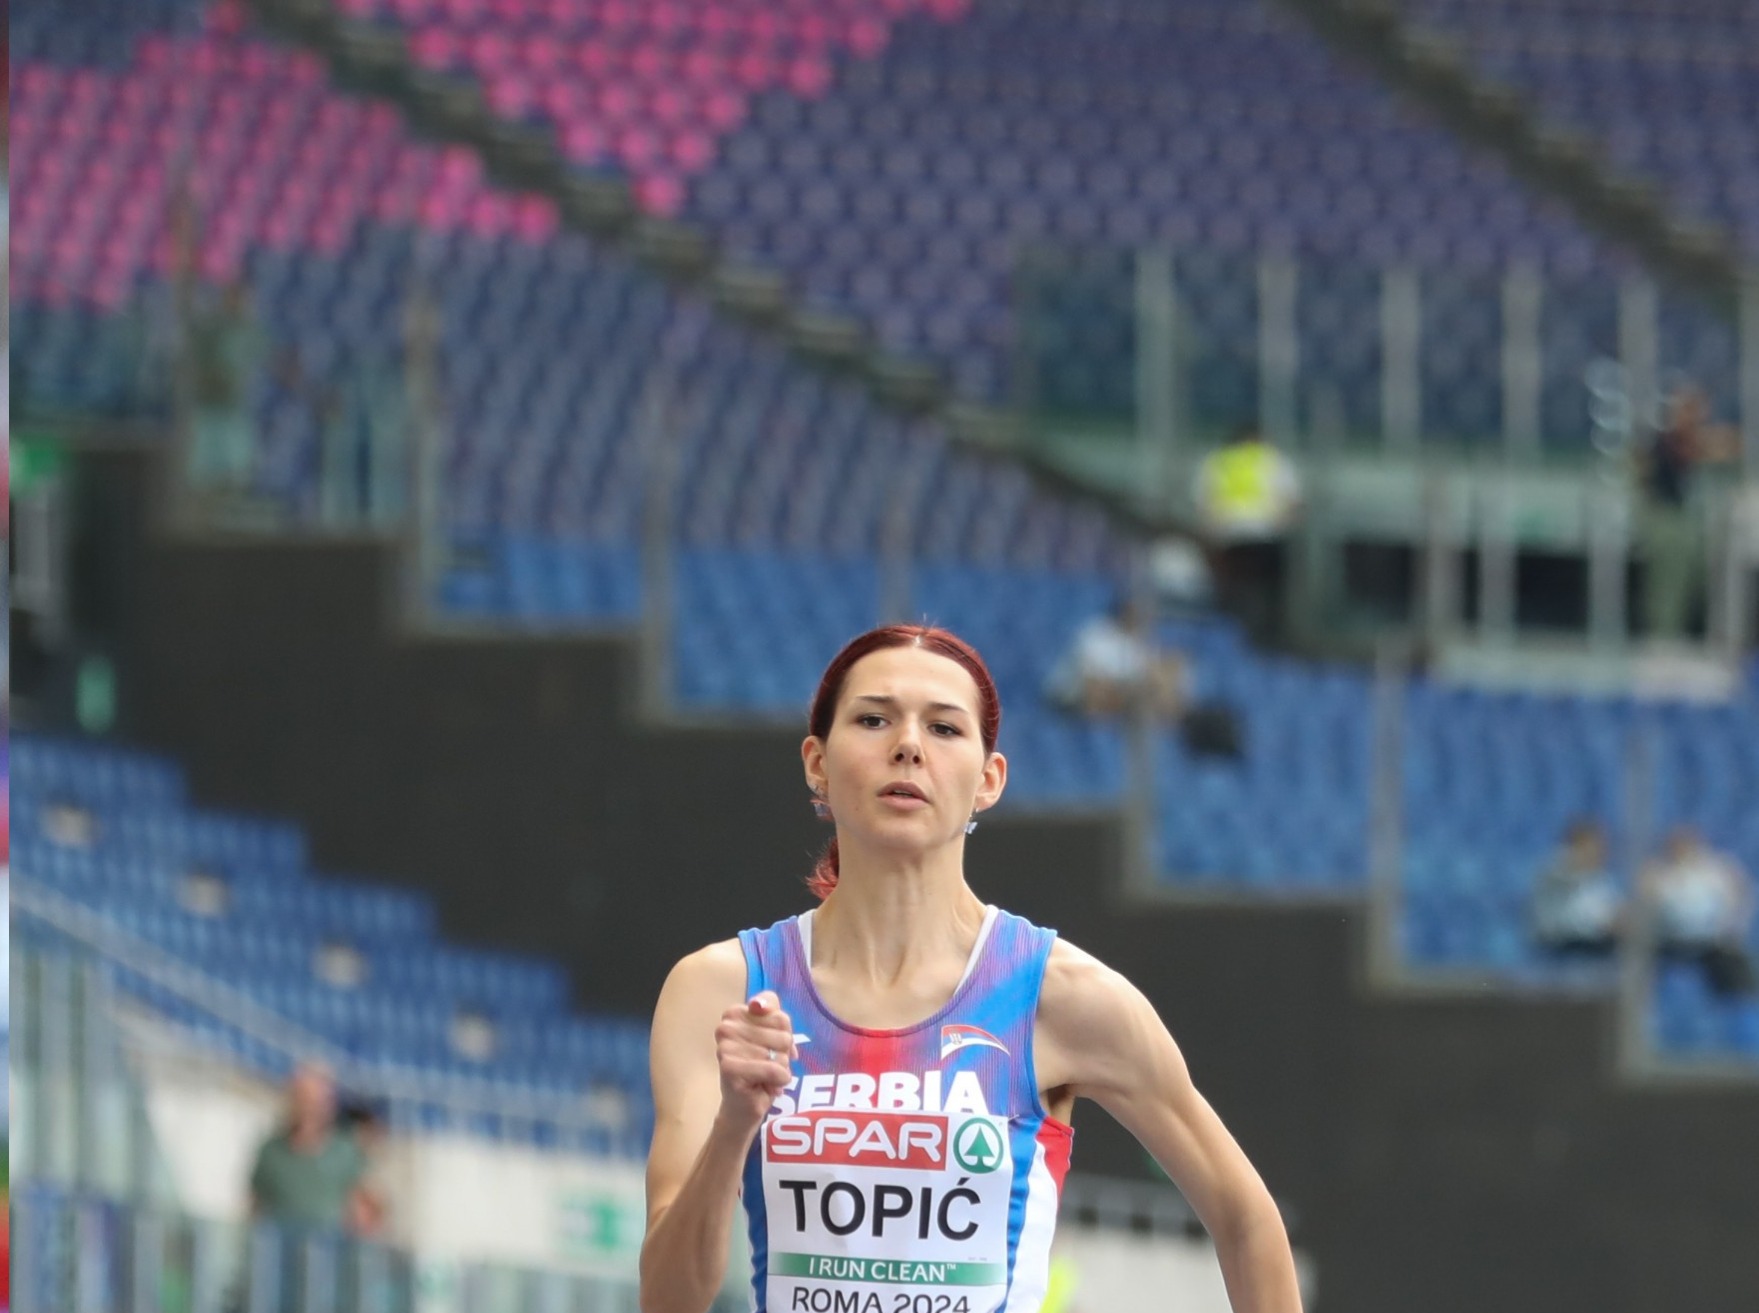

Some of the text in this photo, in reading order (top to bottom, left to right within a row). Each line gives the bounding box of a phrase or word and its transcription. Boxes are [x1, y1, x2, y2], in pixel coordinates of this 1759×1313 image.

[771, 1117, 942, 1162] SPAR
[779, 1177, 981, 1241] TOPIĆ
[809, 1257, 815, 1275] I
[819, 1258, 865, 1279] RUN
